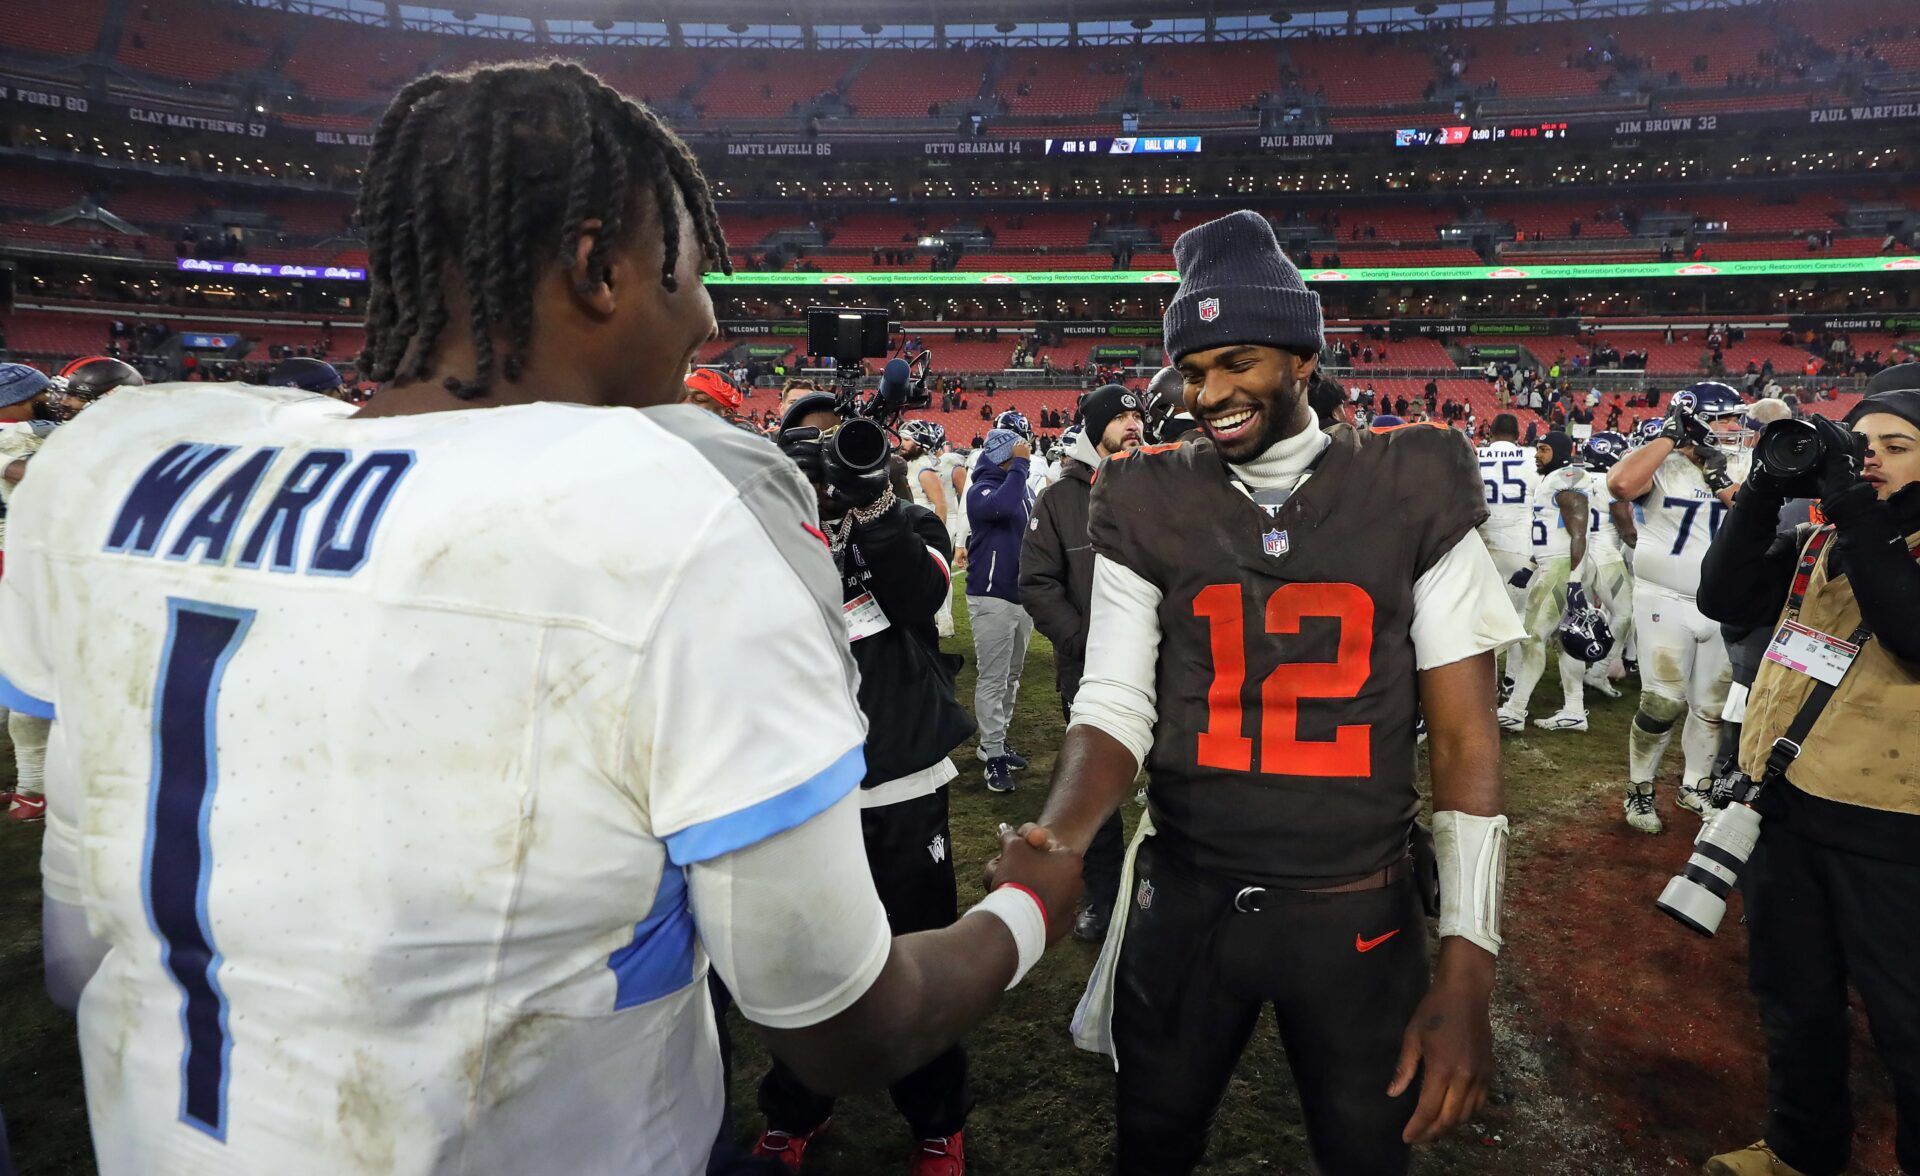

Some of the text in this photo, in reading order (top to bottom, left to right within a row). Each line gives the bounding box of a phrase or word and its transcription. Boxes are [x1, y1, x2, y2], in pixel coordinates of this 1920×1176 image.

[17, 90, 61, 107] FORD
[66, 97, 89, 113] 80
[1810, 109, 1848, 122] PAUL
[130, 109, 267, 138] CLAY MATTHEWS 57
[1616, 116, 1717, 134] JIM BROWN 32
[316, 132, 344, 145] BILL
[1418, 133, 1426, 141] 31
[1472, 130, 1490, 140] 0:00
[1510, 128, 1523, 137] 4TH
[1530, 128, 1538, 136] 10
[1062, 141, 1097, 152] 4TH & 10
[1144, 140, 1161, 151] BALL
[1164, 140, 1174, 151] ON
[1260, 135, 1333, 147] PAUL BROWN
[728, 143, 832, 155] DANTE LAVELLI 86
[925, 141, 1021, 154] OTTO GRAHAM 14
[1815, 261, 1864, 269] Construction
[1202, 307, 1217, 319] NFL
[1825, 320, 1881, 329] WELCOME TO
[1479, 449, 1523, 458] LATHAM
[1479, 460, 1527, 504] 55
[102, 441, 418, 578] WARD
[1266, 540, 1286, 552] NFL
[1192, 583, 1374, 778] 12
[140, 596, 258, 1145] 1
